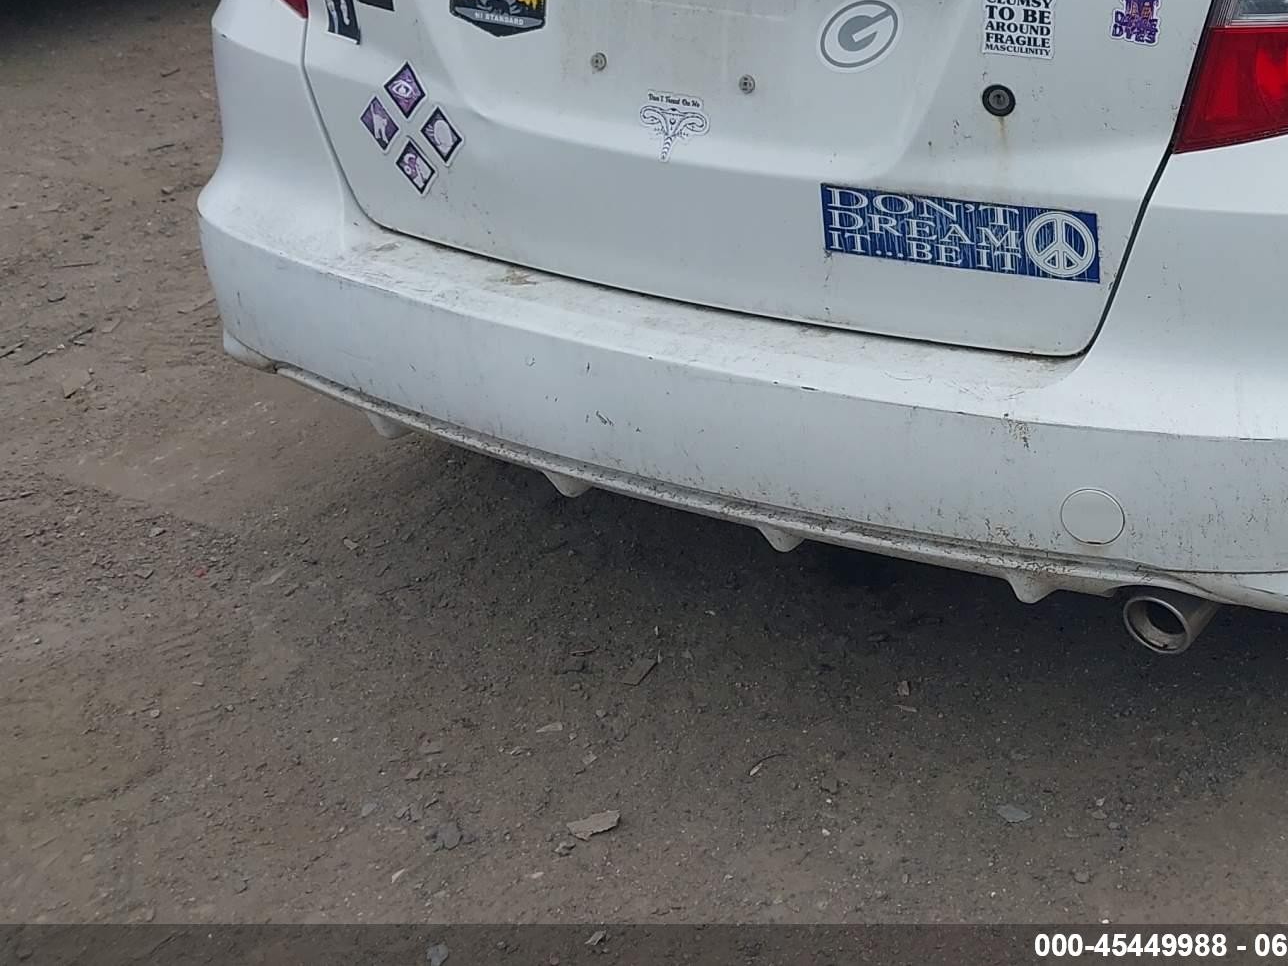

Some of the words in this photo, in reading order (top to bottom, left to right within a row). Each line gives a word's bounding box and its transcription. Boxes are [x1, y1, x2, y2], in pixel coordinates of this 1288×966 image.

[485, 13, 524, 26] STANDARD
[985, 5, 1015, 21] TO
[1022, 9, 1052, 25] BE
[985, 20, 1051, 36] AROUND
[985, 32, 1051, 48] FRAGILE
[985, 43, 1051, 56] MASCULINITY
[825, 187, 1020, 227] DON'T
[827, 209, 1021, 250] DREAM
[976, 251, 1022, 271] IT
